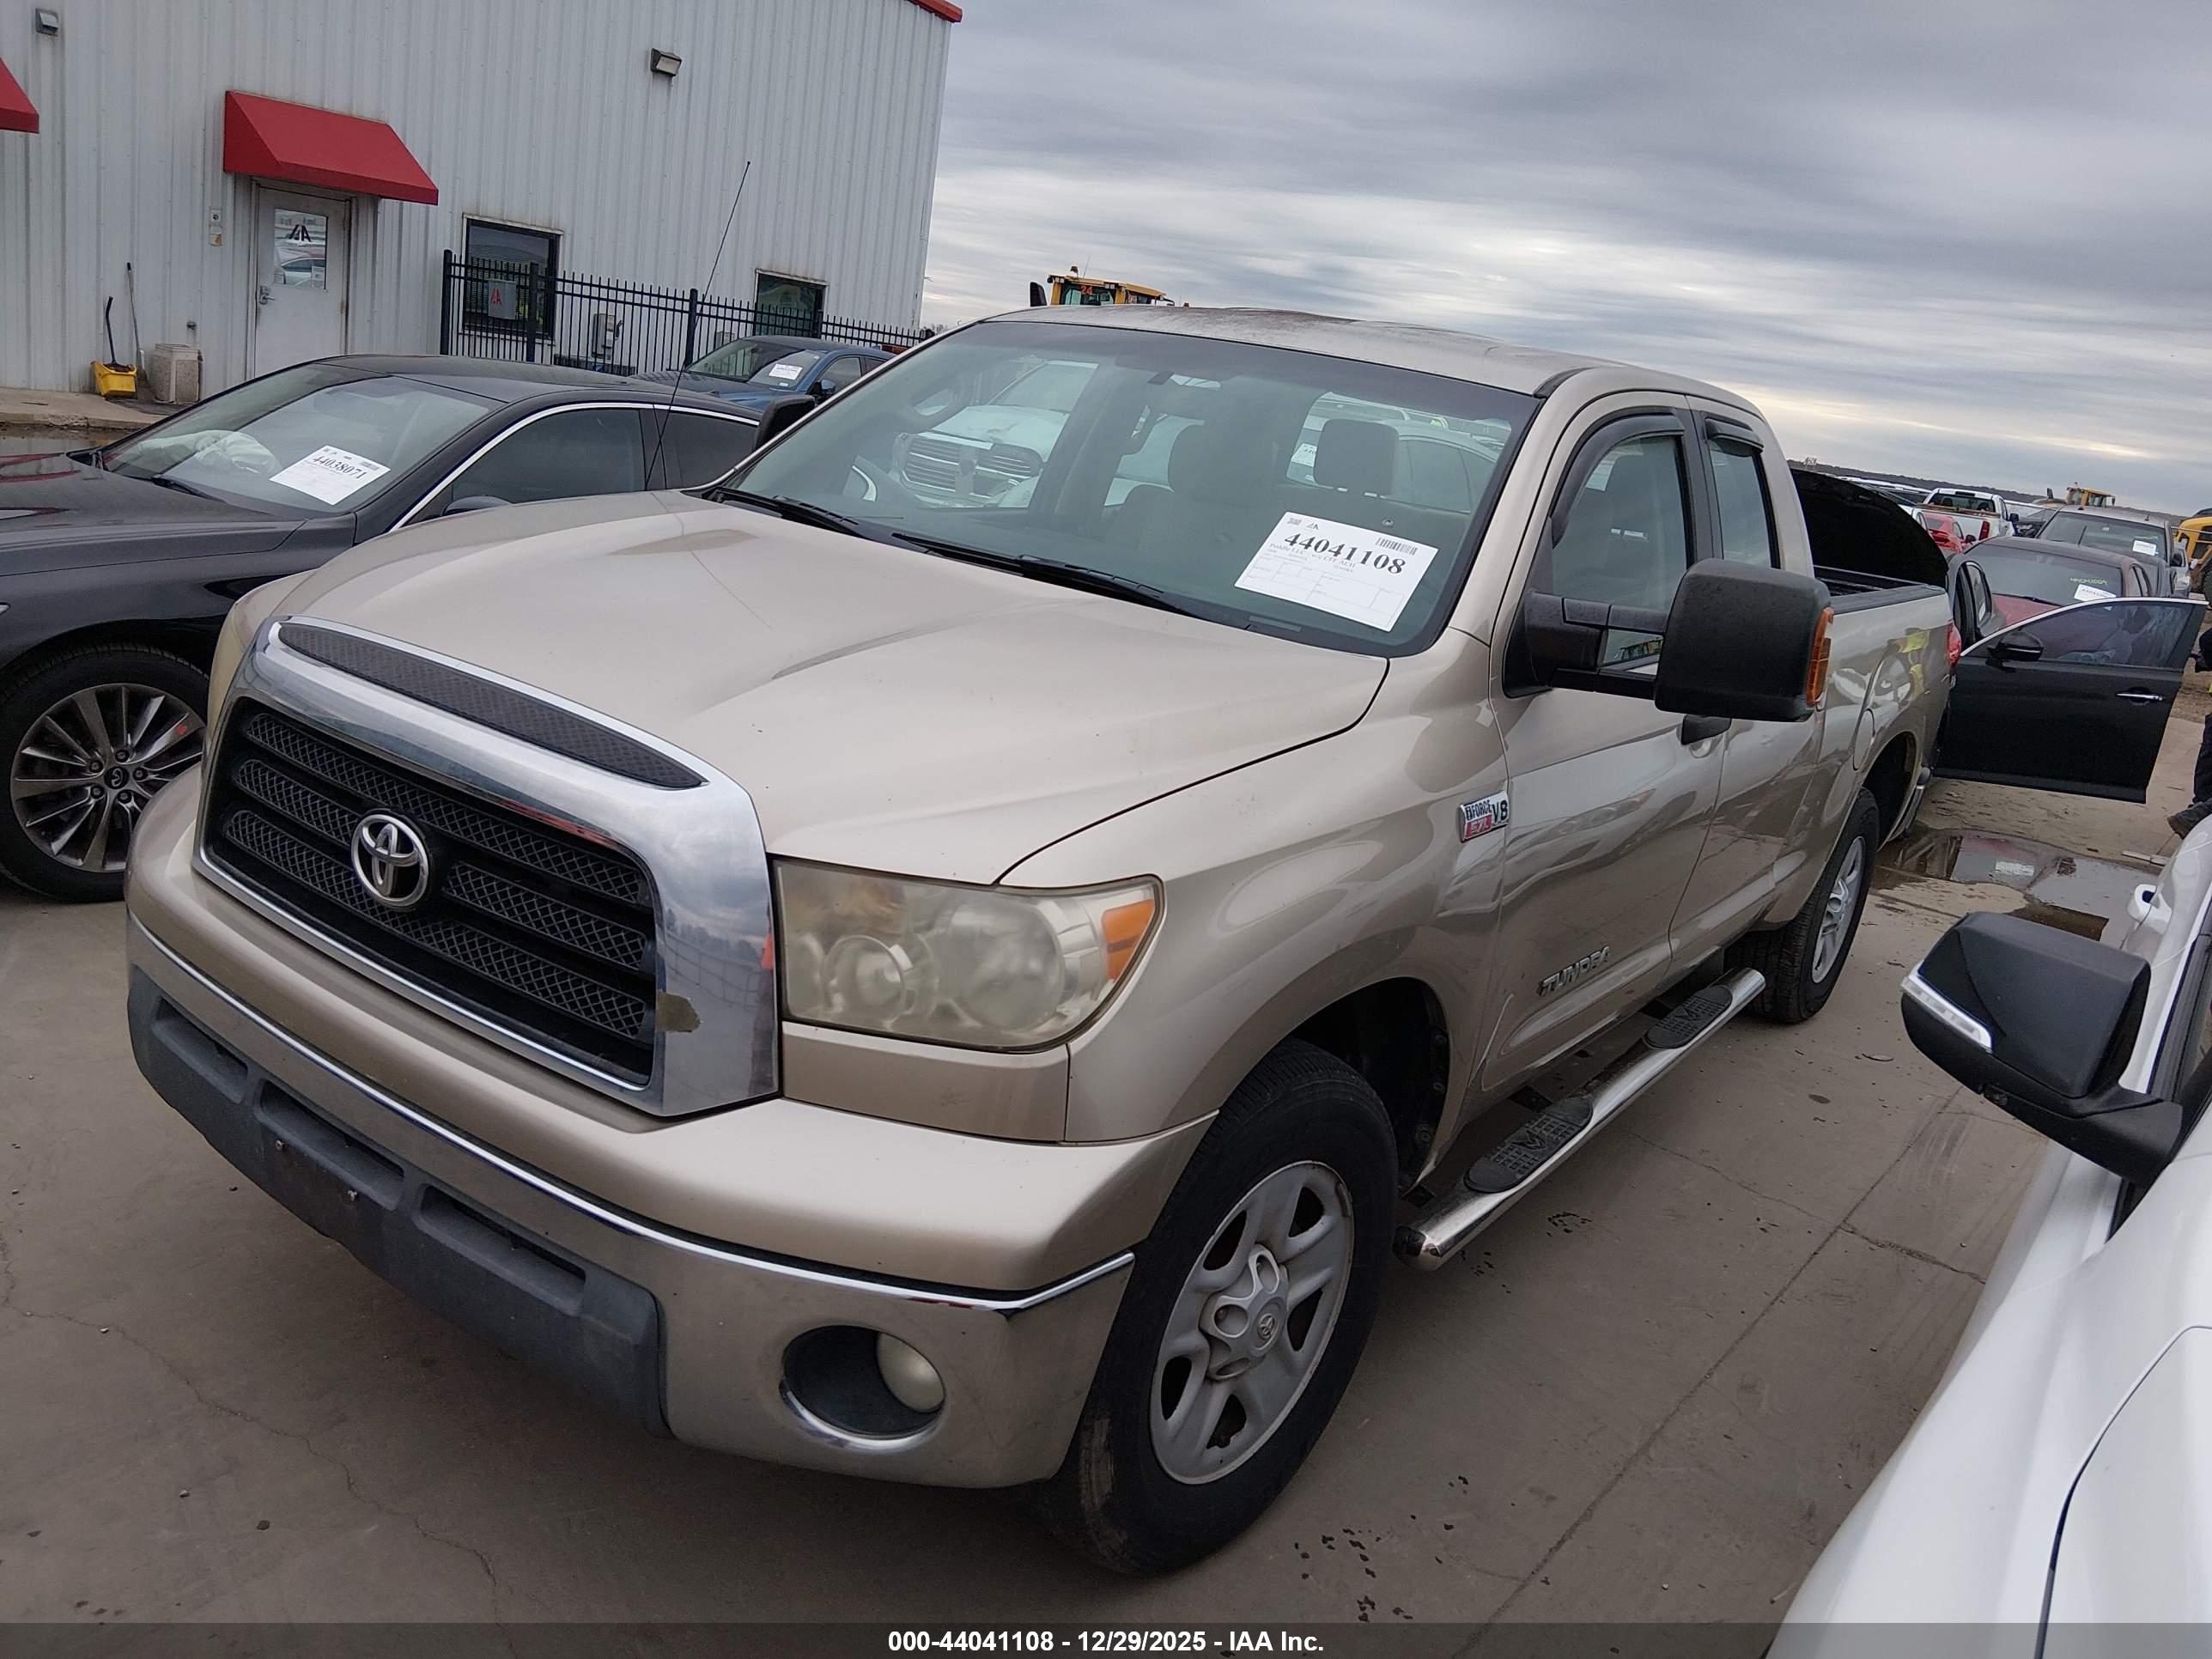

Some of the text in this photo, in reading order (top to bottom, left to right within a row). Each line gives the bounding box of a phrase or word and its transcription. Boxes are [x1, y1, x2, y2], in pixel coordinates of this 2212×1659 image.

[1080, 285, 1093, 295] 24
[313, 455, 368, 479] 44038071
[1284, 533, 1407, 574] 44041108
[1492, 799, 1508, 823] V8
[1537, 945, 1610, 996] TUNDRA
